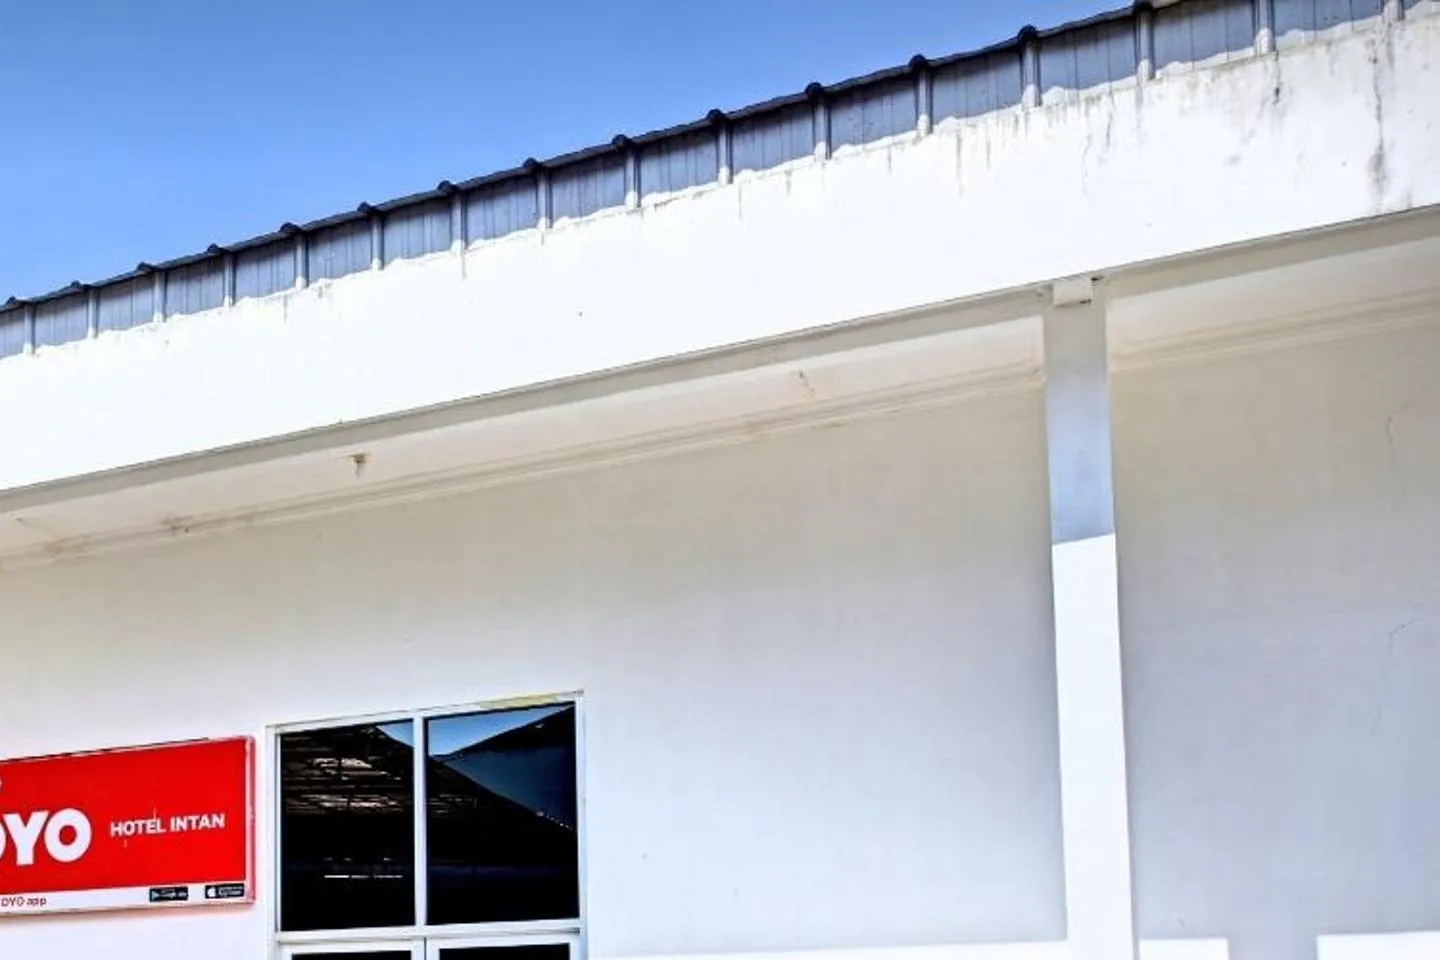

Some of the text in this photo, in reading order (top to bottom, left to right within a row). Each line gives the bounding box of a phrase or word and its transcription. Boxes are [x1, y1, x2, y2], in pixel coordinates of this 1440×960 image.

[110, 813, 225, 837] HOTEL INTAN
[1, 896, 24, 907] OYO
[26, 897, 47, 906] app
